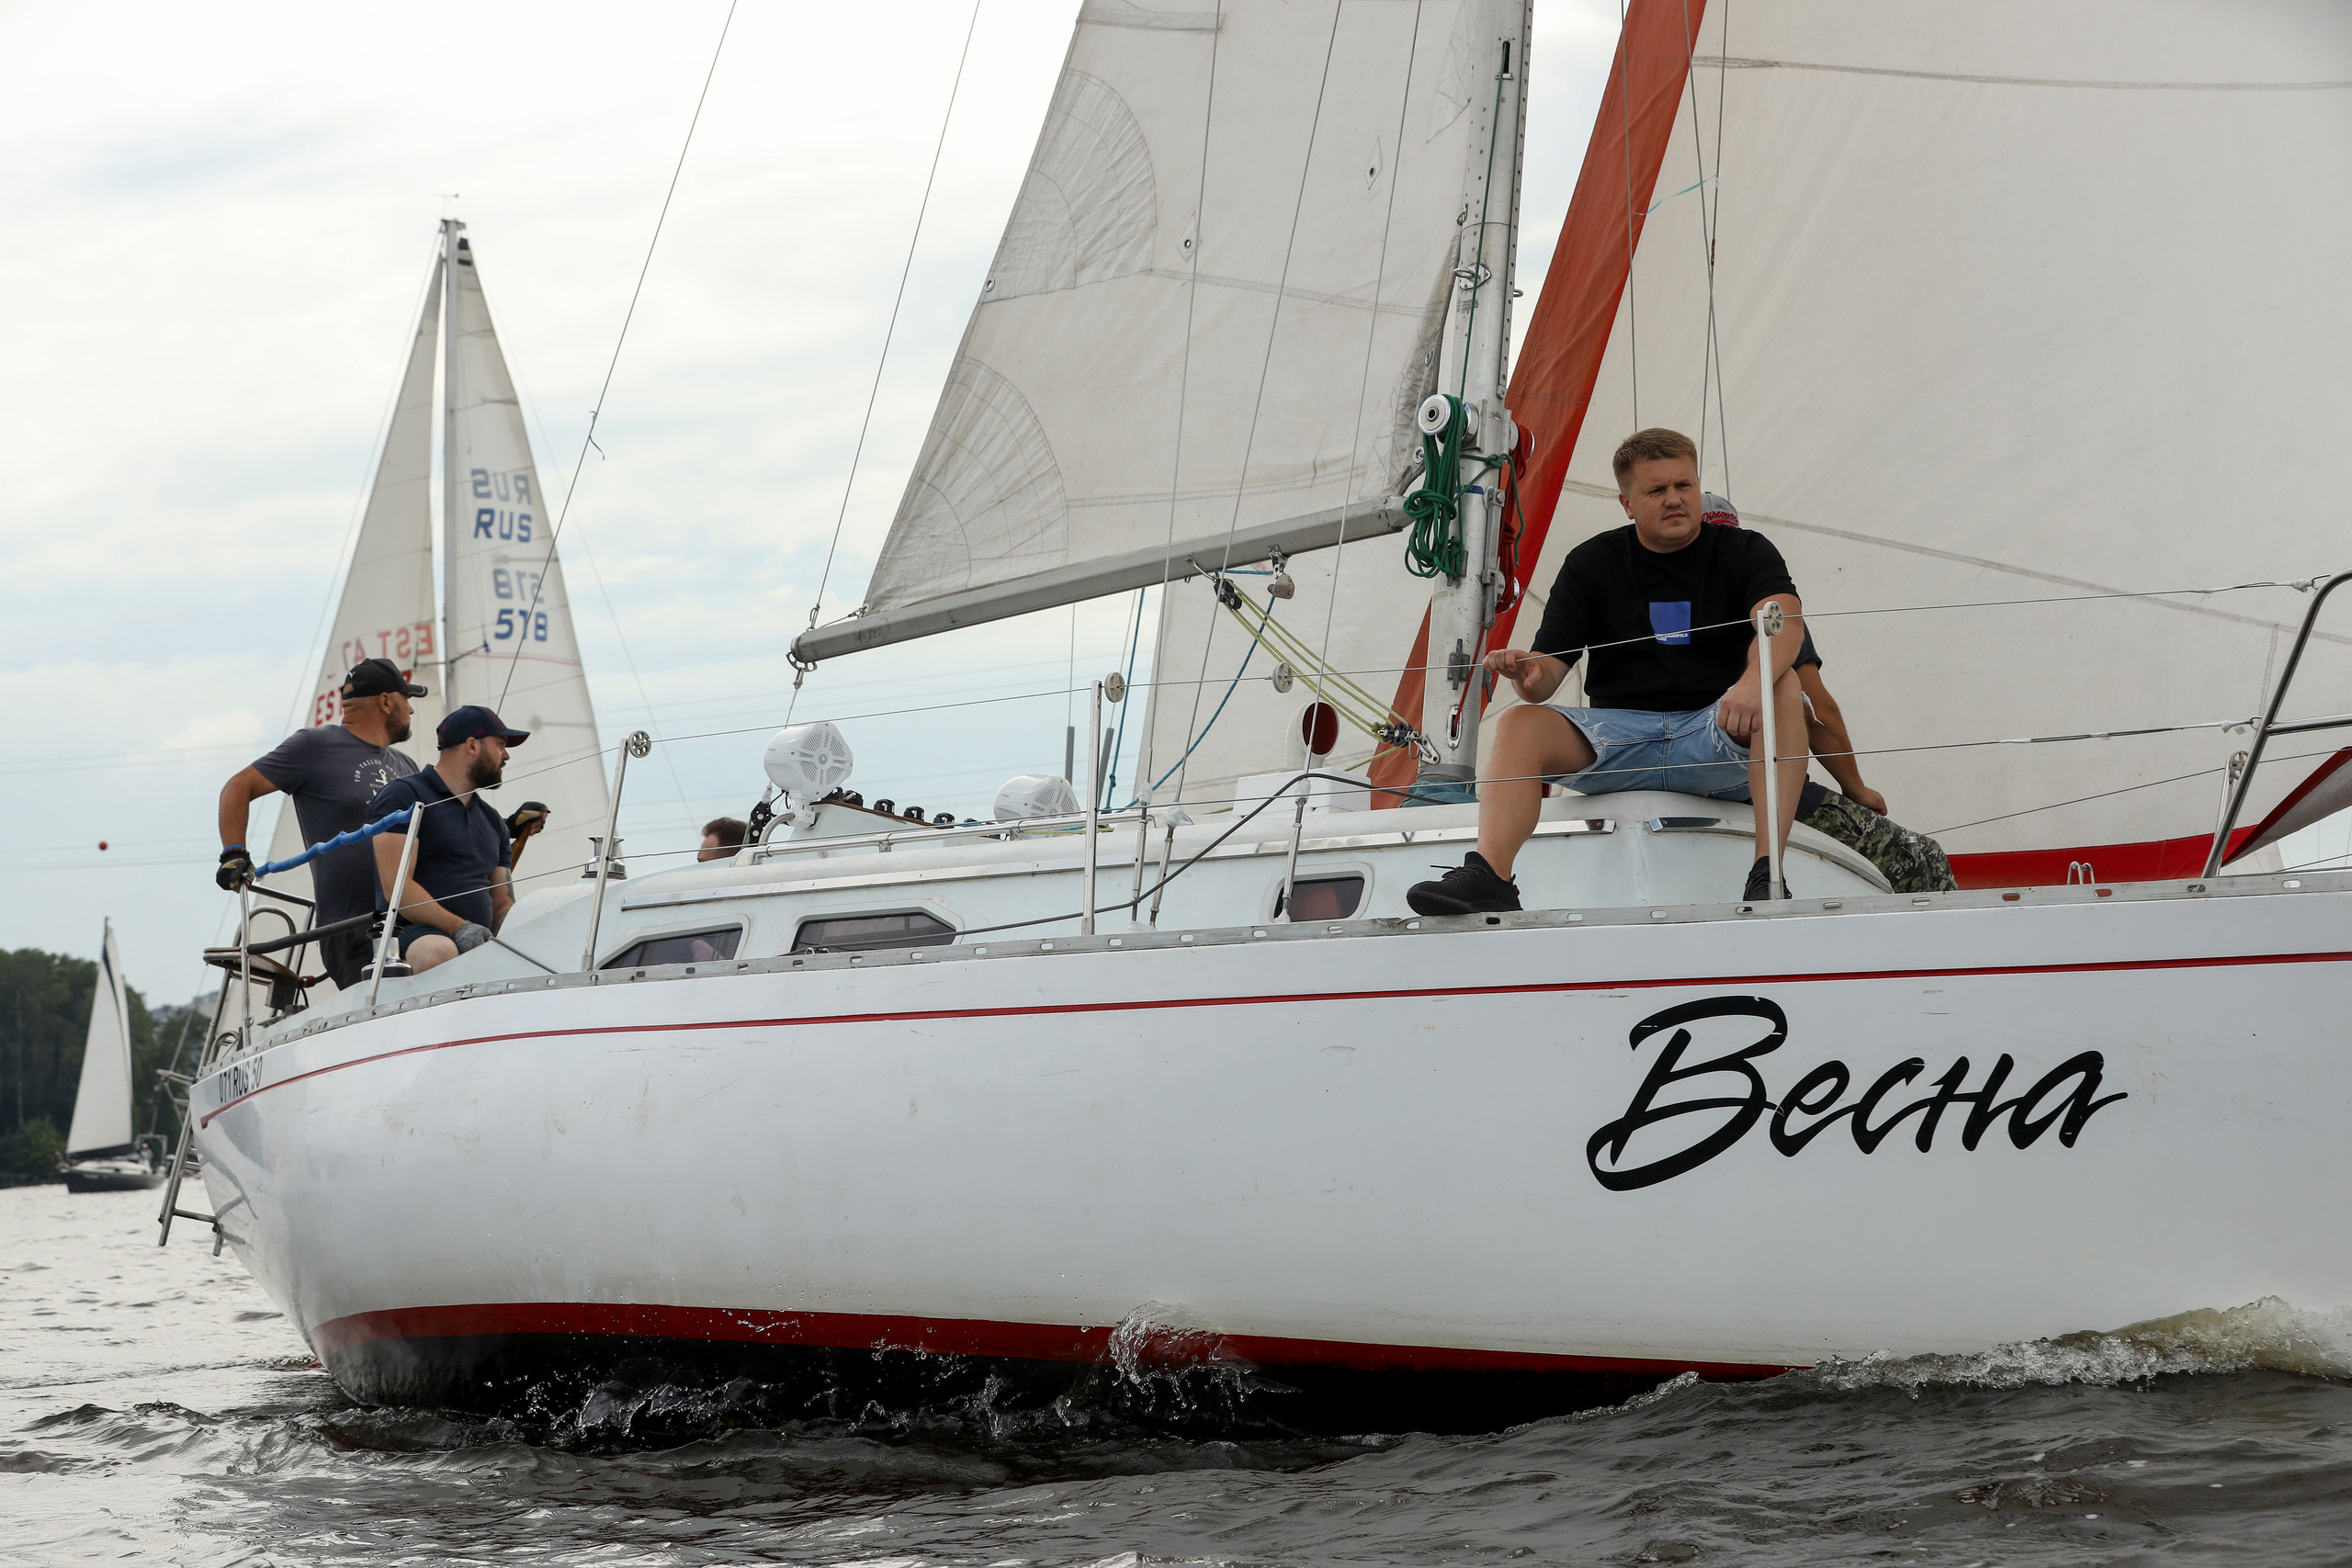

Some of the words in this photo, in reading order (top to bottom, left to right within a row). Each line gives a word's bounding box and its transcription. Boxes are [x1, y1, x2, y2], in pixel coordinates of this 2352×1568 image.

[474, 508, 532, 543] RUS
[493, 608, 548, 642] 578
[359, 759, 381, 769] TAILOR
[233, 1059, 250, 1099] RUS
[1587, 996, 2128, 1192] Весна
